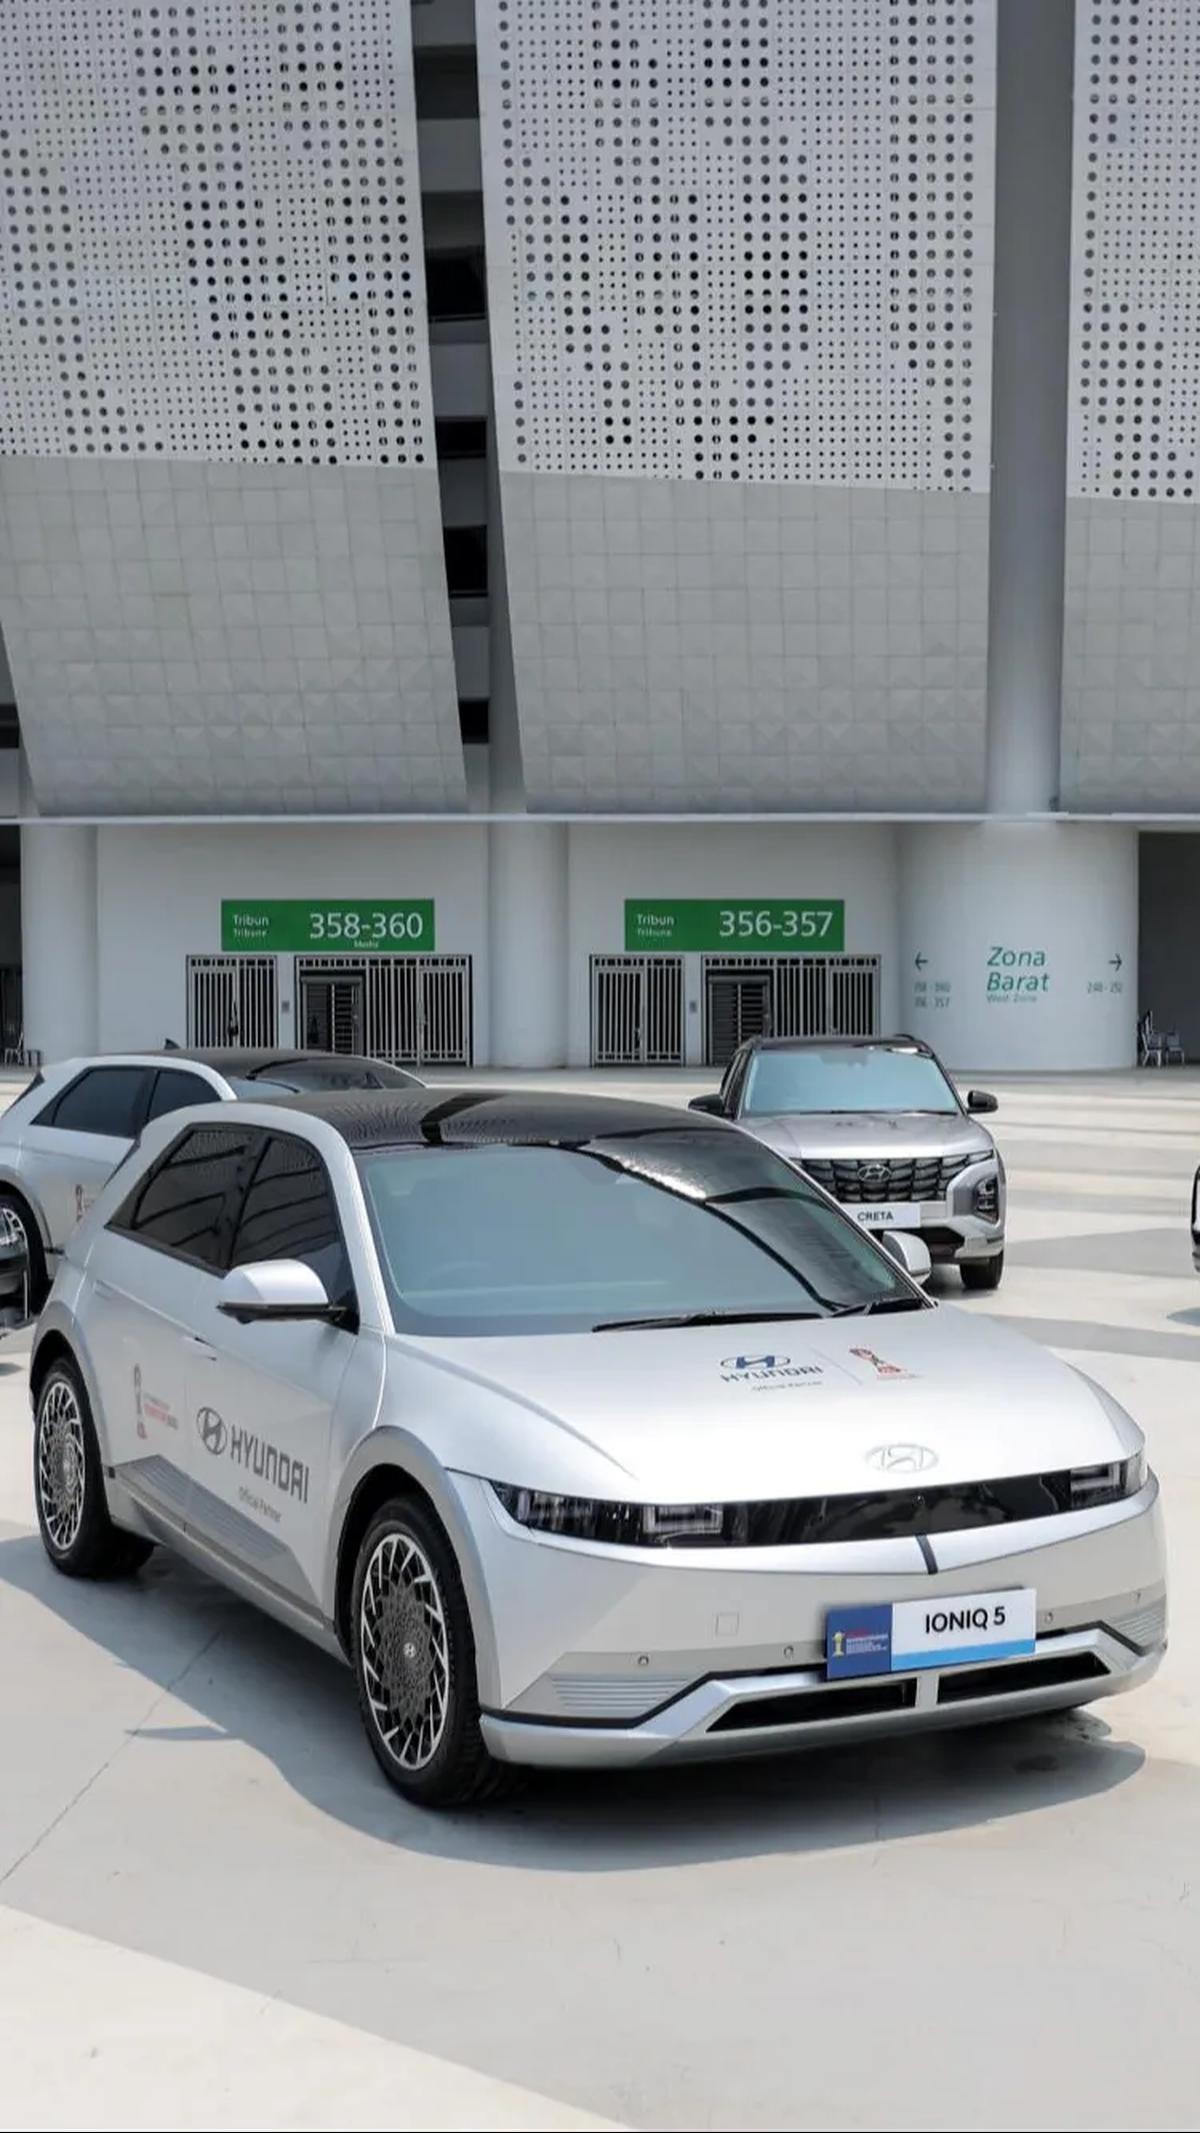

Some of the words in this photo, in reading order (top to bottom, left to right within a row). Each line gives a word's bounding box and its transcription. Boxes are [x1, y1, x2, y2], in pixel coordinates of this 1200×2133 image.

[233, 914, 269, 926] Tribun
[310, 913, 423, 939] 358-360
[637, 913, 675, 926] Tribun
[719, 911, 833, 937] 356-357
[987, 947, 1045, 967] Zona
[987, 972, 1050, 992] Barat
[857, 1211, 893, 1221] CRETA
[720, 1366, 824, 1382] HYUNDAI
[230, 1424, 309, 1504] HYUNDAI
[926, 1608, 989, 1634] IONIQ
[993, 1606, 1006, 1626] 5
